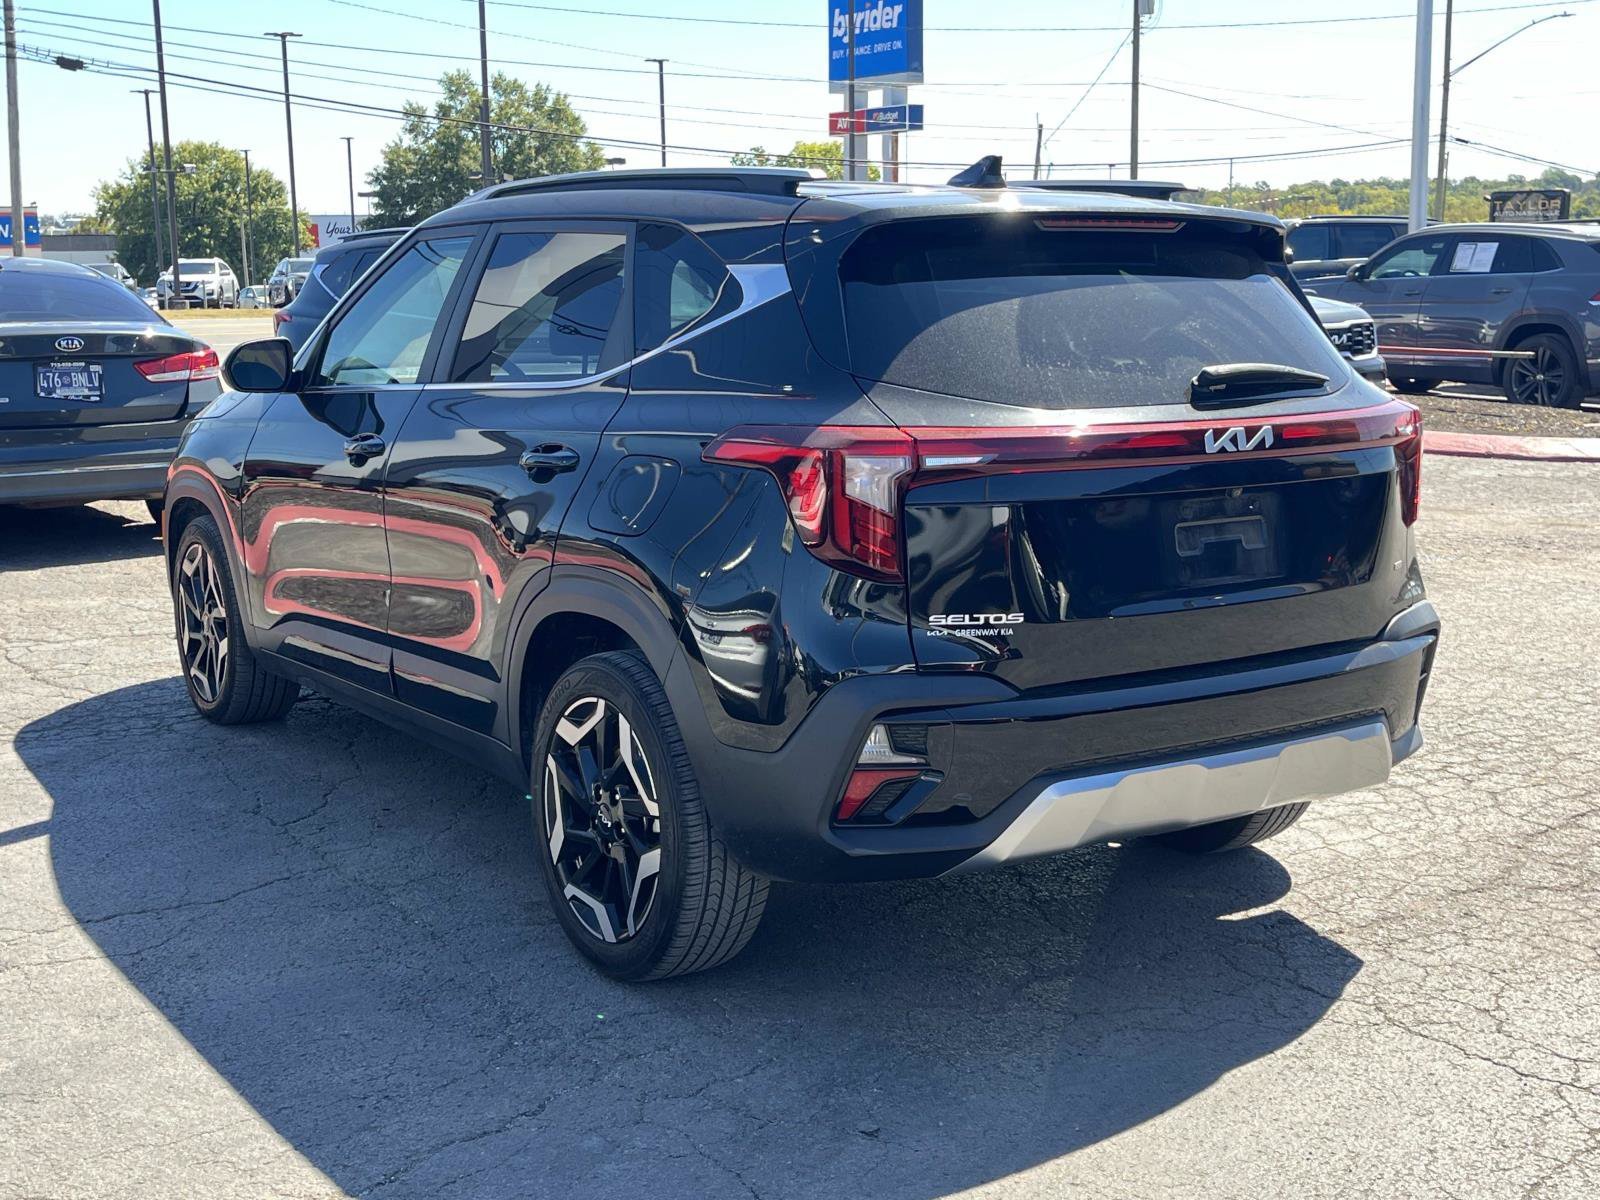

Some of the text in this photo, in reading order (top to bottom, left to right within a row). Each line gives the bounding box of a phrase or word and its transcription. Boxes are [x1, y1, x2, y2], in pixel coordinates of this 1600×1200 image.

[832, 0, 903, 44] byrider
[873, 41, 892, 53] DRIVE
[879, 111, 899, 123] Budget
[1494, 199, 1561, 211] TAYLOR
[326, 221, 352, 238] Your
[40, 371, 99, 388] 476 BNLV
[1204, 425, 1274, 454] KIA
[928, 612, 1025, 626] SELTOS
[955, 628, 999, 637] GREENWAY
[1000, 627, 1014, 636] KIA
